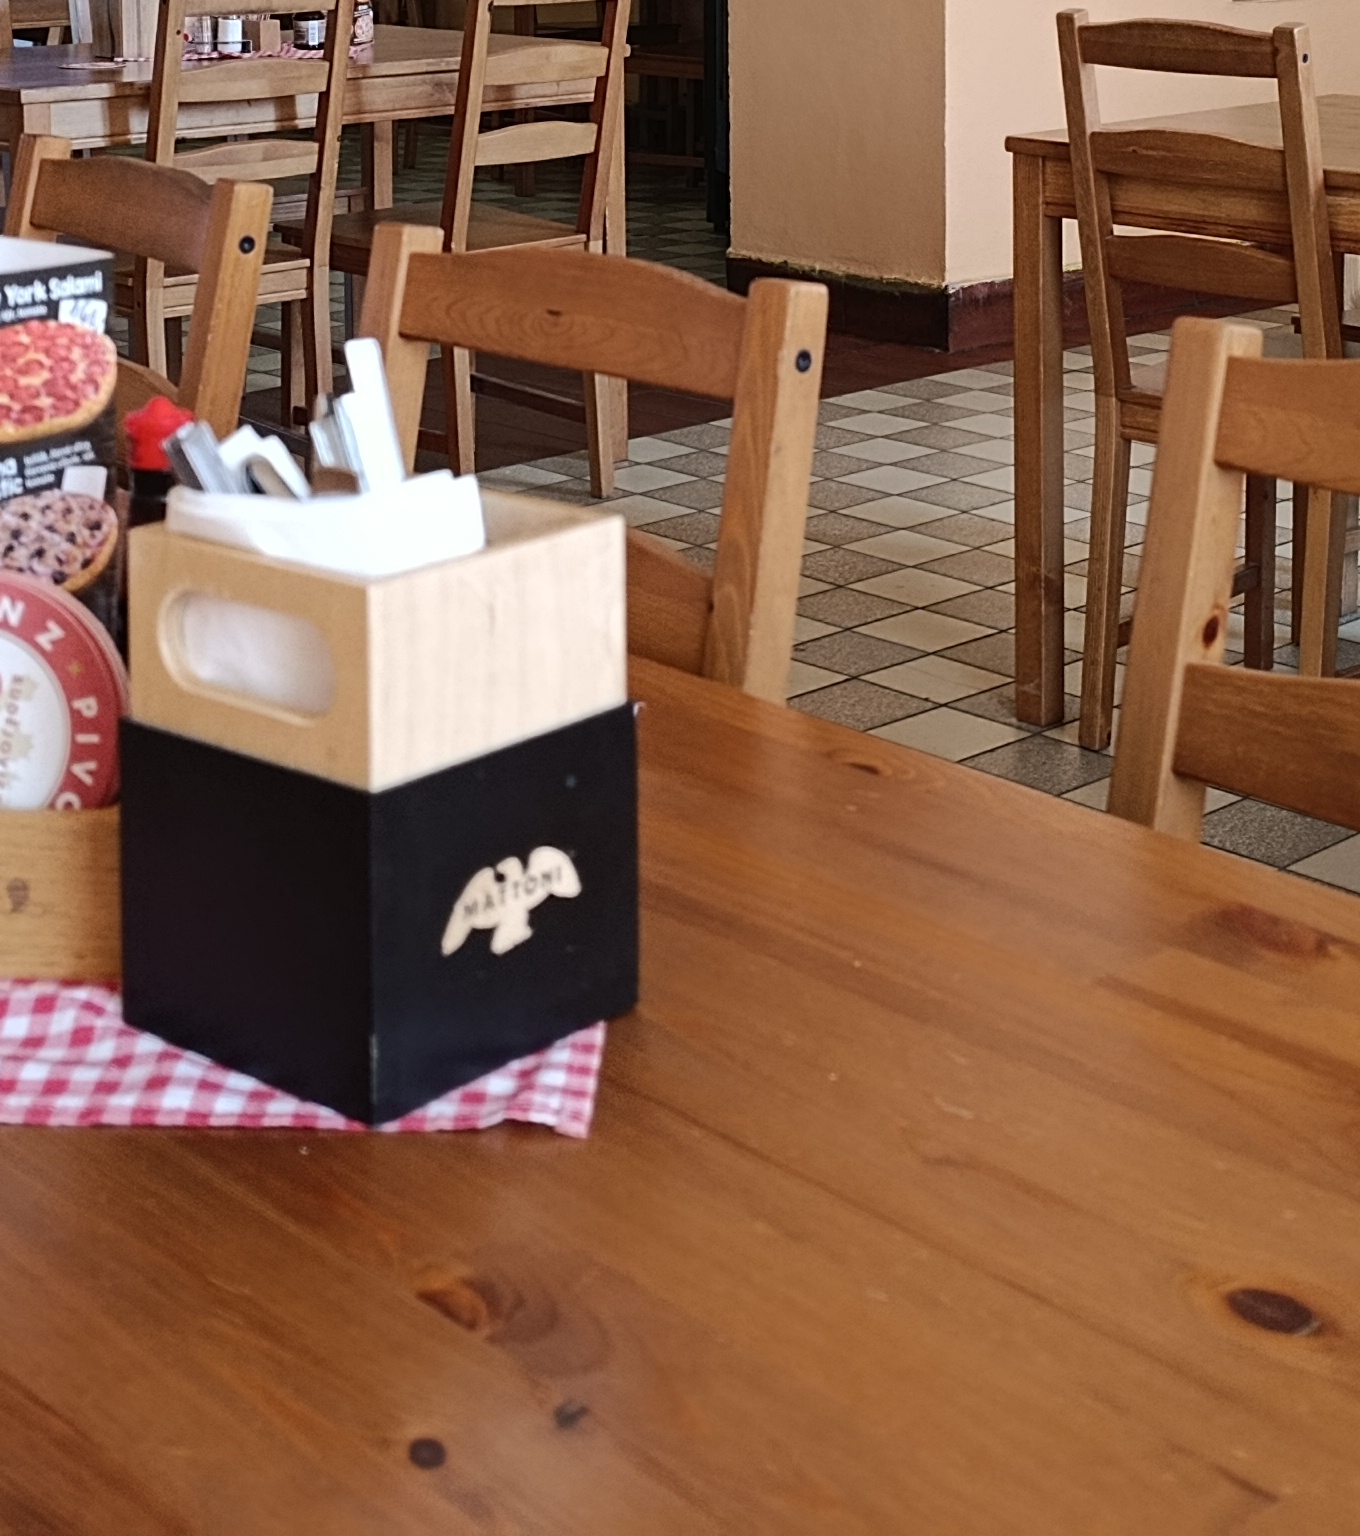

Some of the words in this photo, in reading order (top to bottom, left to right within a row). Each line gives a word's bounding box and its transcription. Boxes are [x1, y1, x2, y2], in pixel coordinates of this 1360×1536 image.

[3, 279, 48, 308] York
[48, 269, 104, 301] Salami
[35, 620, 65, 652] Z
[462, 866, 563, 921] MATTONI
